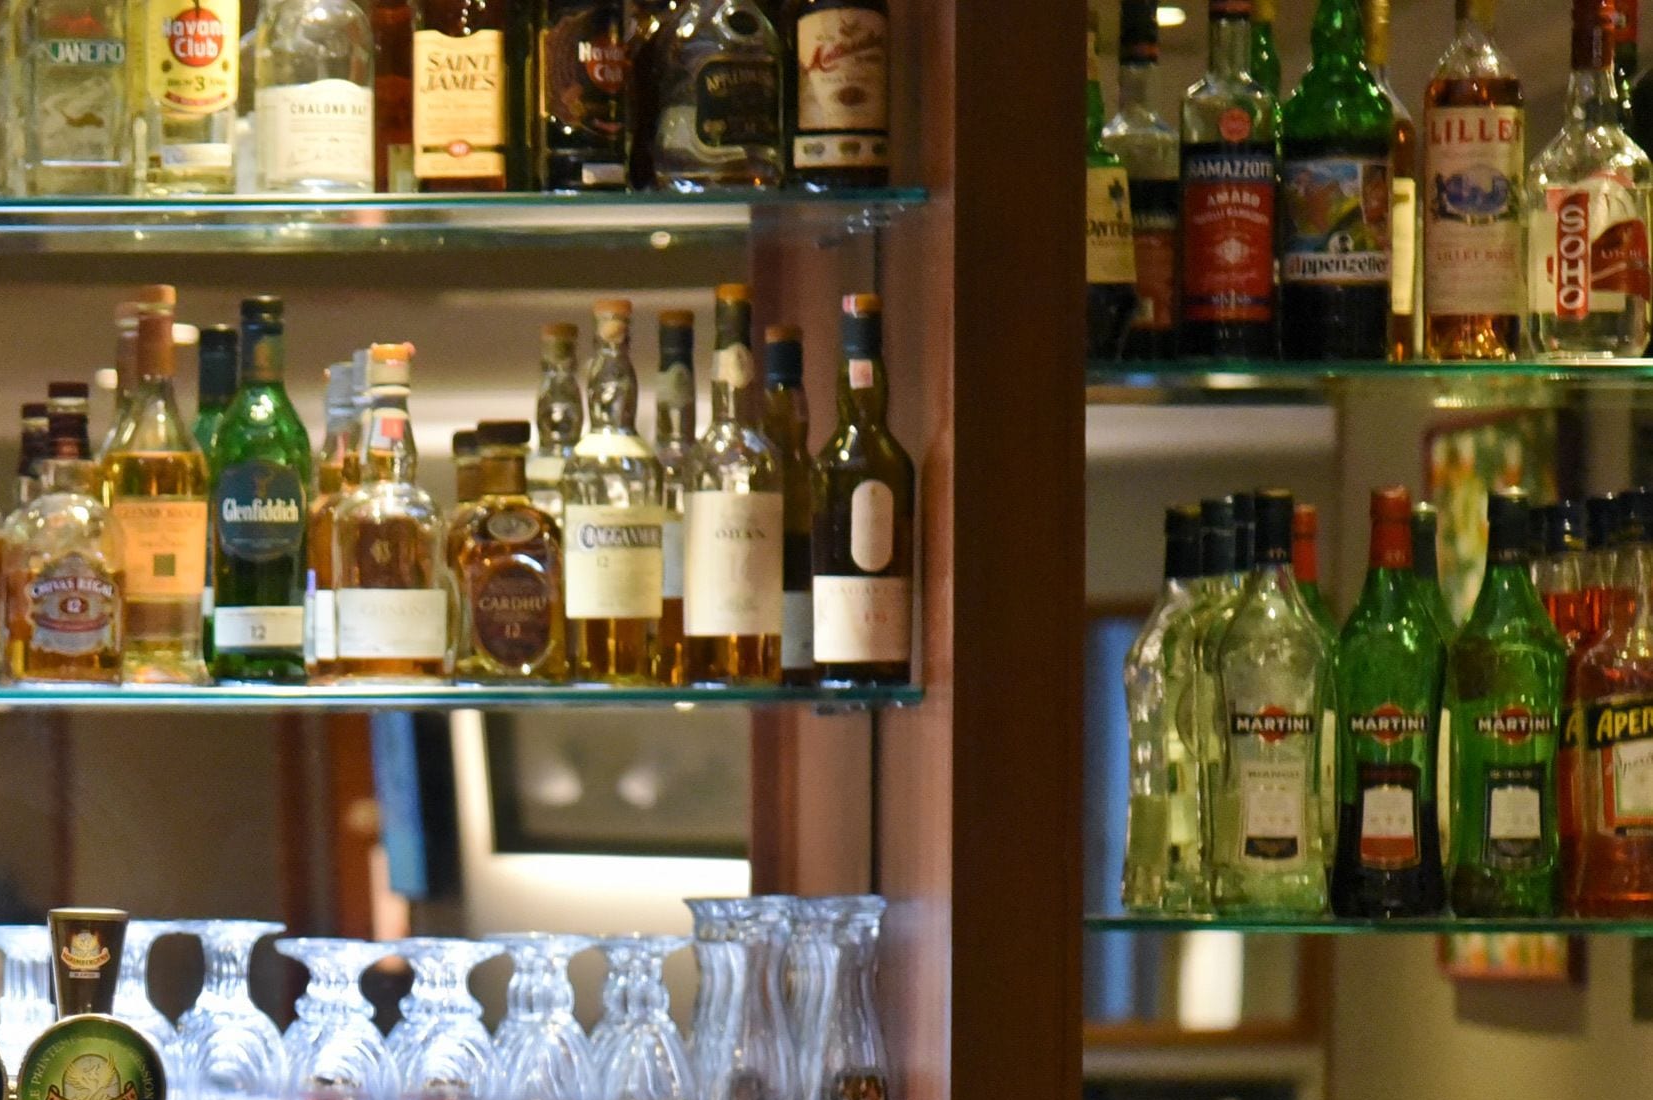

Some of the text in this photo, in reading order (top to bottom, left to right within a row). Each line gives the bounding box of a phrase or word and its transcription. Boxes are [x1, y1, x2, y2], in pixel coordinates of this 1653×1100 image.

[174, 37, 218, 57] Club
[427, 52, 496, 72] SAINT
[195, 75, 205, 91] 3
[420, 73, 497, 92] JAMES
[290, 103, 347, 114] CHALONG
[1207, 190, 1261, 208] AMARO
[1559, 204, 1585, 310] SOHO
[222, 497, 298, 523] Glenfiddich
[478, 596, 545, 610] CARDHU
[250, 625, 267, 640] 12
[1236, 716, 1311, 731] MARTINI
[1351, 716, 1426, 731] MARTINI
[1477, 716, 1551, 732] MARTINI
